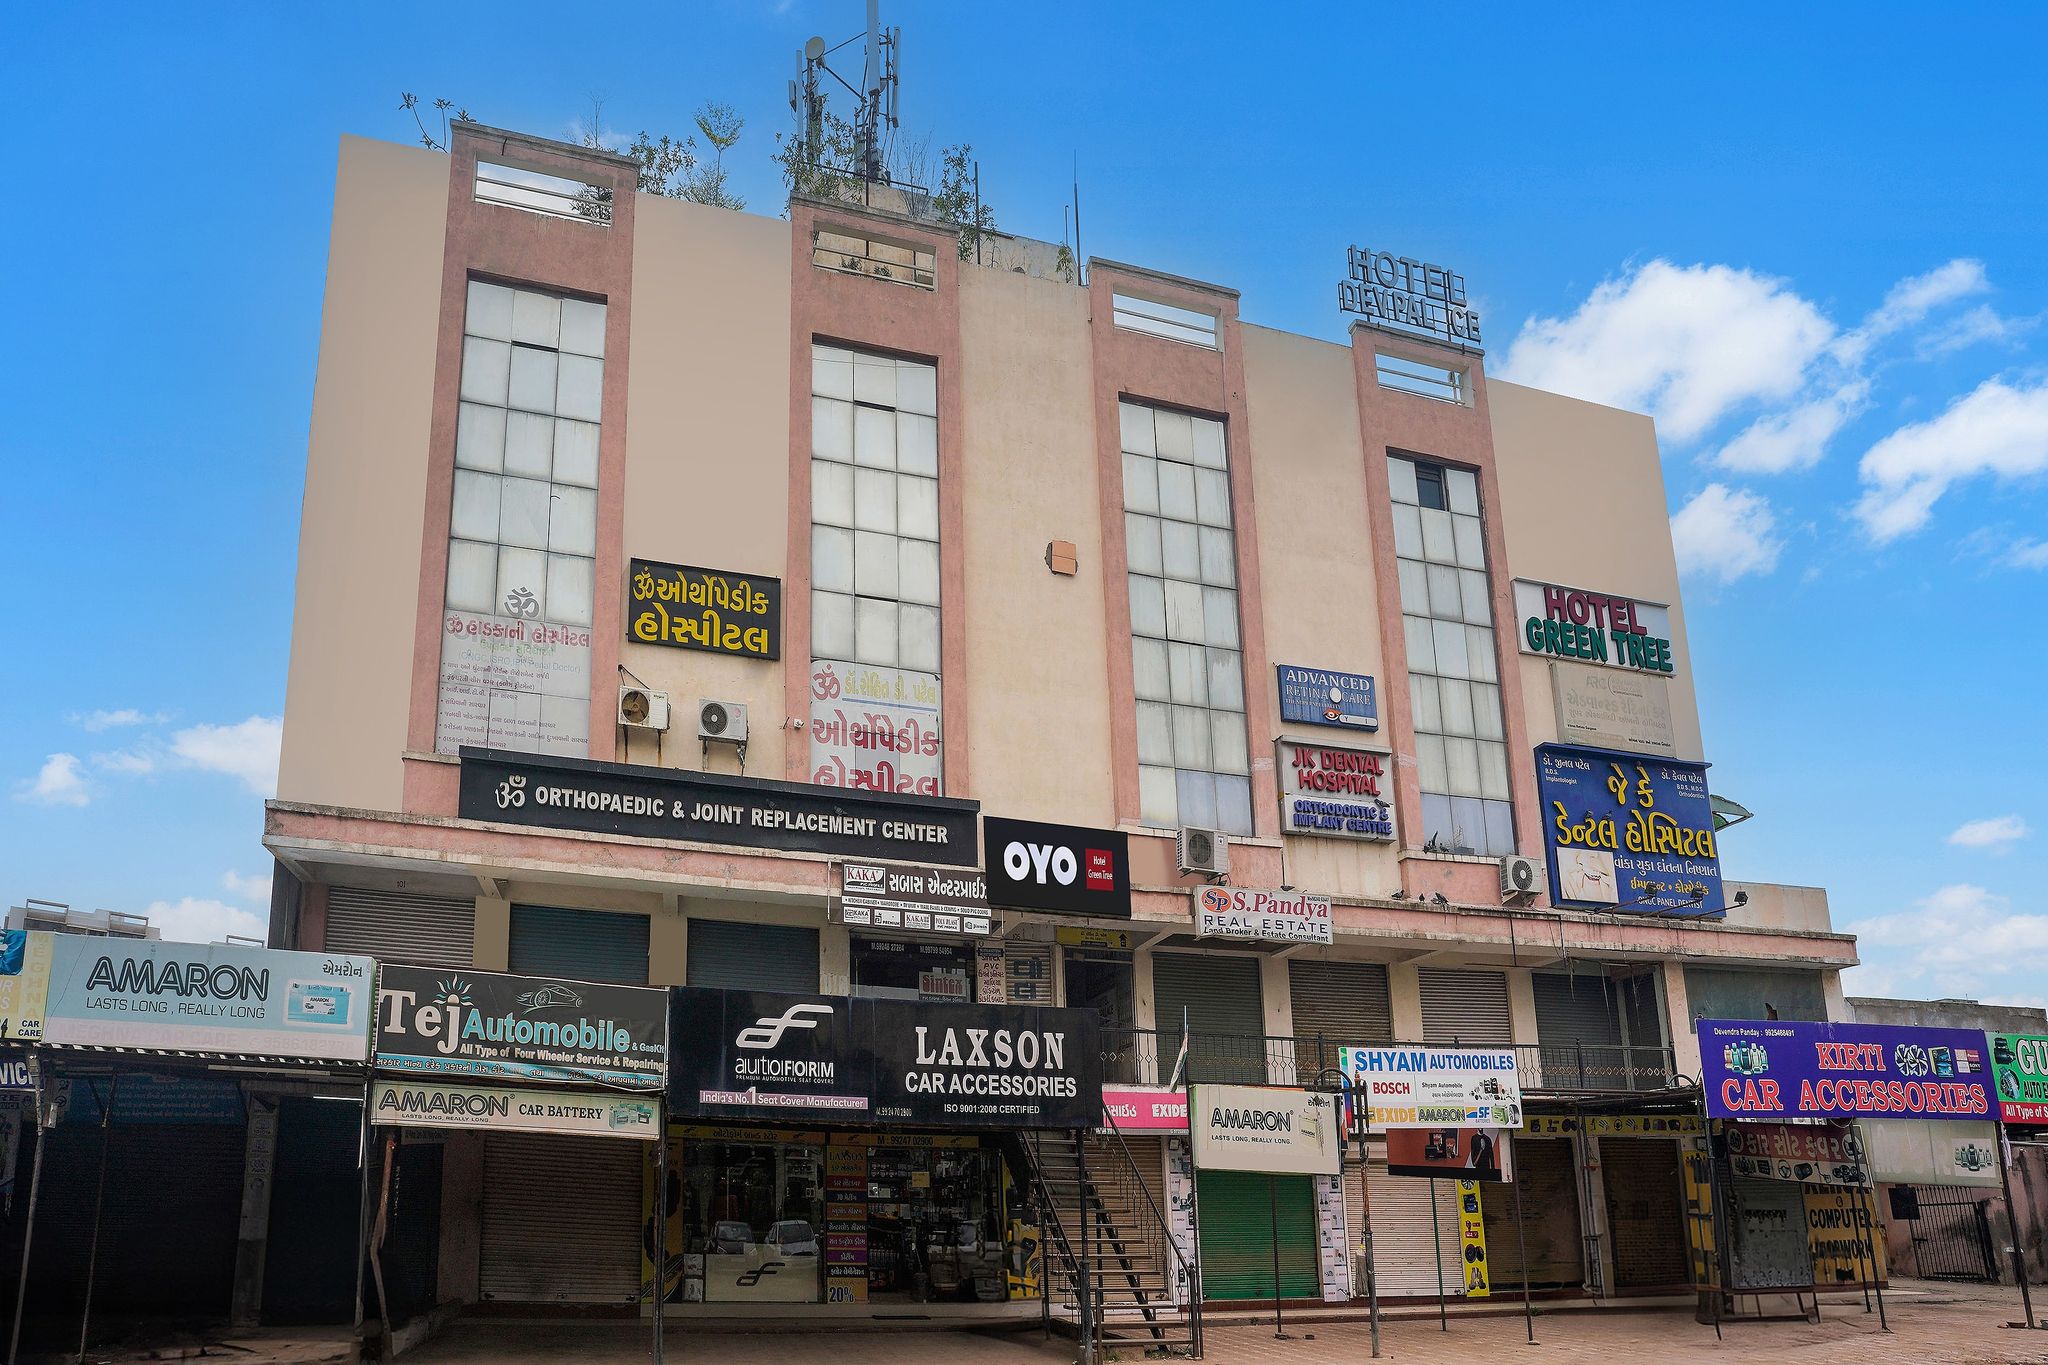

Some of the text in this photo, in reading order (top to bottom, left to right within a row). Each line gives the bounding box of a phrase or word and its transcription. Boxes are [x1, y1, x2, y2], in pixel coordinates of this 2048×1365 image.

[1350, 244, 1467, 308] HOTEL
[1544, 585, 1647, 636] HOTEL
[634, 602, 768, 654] હોસ્પીટલ
[1526, 616, 1673, 673] GREEN TREE
[1286, 669, 1370, 691] ADVANCED
[1286, 684, 1371, 705] RETINA CARE
[1292, 747, 1384, 776] JK DENTAL
[1575, 757, 1590, 770] પટેલ
[1298, 768, 1381, 796] HOSPITAL
[1607, 762, 1654, 808] જે કે
[1688, 772, 1703, 784] પટેલ
[535, 785, 948, 844] ORTHOPAEDIC & JOINT REPLACEMENT CENTER
[1294, 799, 1389, 821] ORTHODONTIC &
[1293, 813, 1392, 835] IMPLANT CENTRE
[1553, 801, 1717, 858] ડેન્ટલ હોસ્પિટલ
[1004, 841, 1077, 886] OYO
[1093, 856, 1106, 865] Hotel
[847, 868, 877, 881] KAKA
[1088, 869, 1113, 880] Green Tree
[1232, 891, 1328, 921] S.Pandya
[1657, 897, 1677, 907] PANEL
[1204, 915, 1328, 934] REAL ESTATE
[1204, 927, 1223, 935] Land
[1226, 927, 1251, 937] Broker
[1261, 930, 1287, 939] Estate
[1288, 932, 1328, 942] Consultant
[322, 959, 362, 977] એમરોન
[85, 956, 270, 1002] AMARON
[922, 975, 963, 994] Sintex
[86, 997, 265, 1019] LASTS REALLY LONG
[22, 1020, 40, 1028] CAR
[380, 988, 460, 1054] Tej
[462, 1009, 631, 1053] Automobile
[18, 1029, 41, 1037] CARE
[460, 1044, 663, 1072] All Type of Four Wheeler Service & Repairing
[915, 1026, 1065, 1070] LAXSON
[1816, 1042, 1886, 1071] KIRTI
[1355, 1051, 1514, 1072] SHYAM AUTOMOBILES
[905, 1072, 1077, 1098] CAR ACCESSORIES
[1373, 1081, 1410, 1095] BOSCH
[2023, 1080, 2042, 1099] AUTO
[379, 1089, 602, 1120] AMARON CAR BATTERY
[702, 1091, 733, 1103] India's
[758, 1094, 778, 1105] Seat
[781, 1095, 804, 1106] Cover
[806, 1097, 864, 1108] Manufacturer
[1721, 1078, 1988, 1115] CAR ACCESSORIES
[944, 1103, 1040, 1115] ISO 9001:2008 CERTIFIED
[1152, 1103, 1187, 1118] EXIDE
[1211, 1107, 1290, 1132] AMARON
[1376, 1106, 1489, 1123] EXIDE AMARON SF
[2006, 1104, 2042, 1120] All Type of
[1252, 1136, 1273, 1144] REALLY
[1810, 1208, 1873, 1228] COMPUTER
[829, 1286, 854, 1303] 20%
